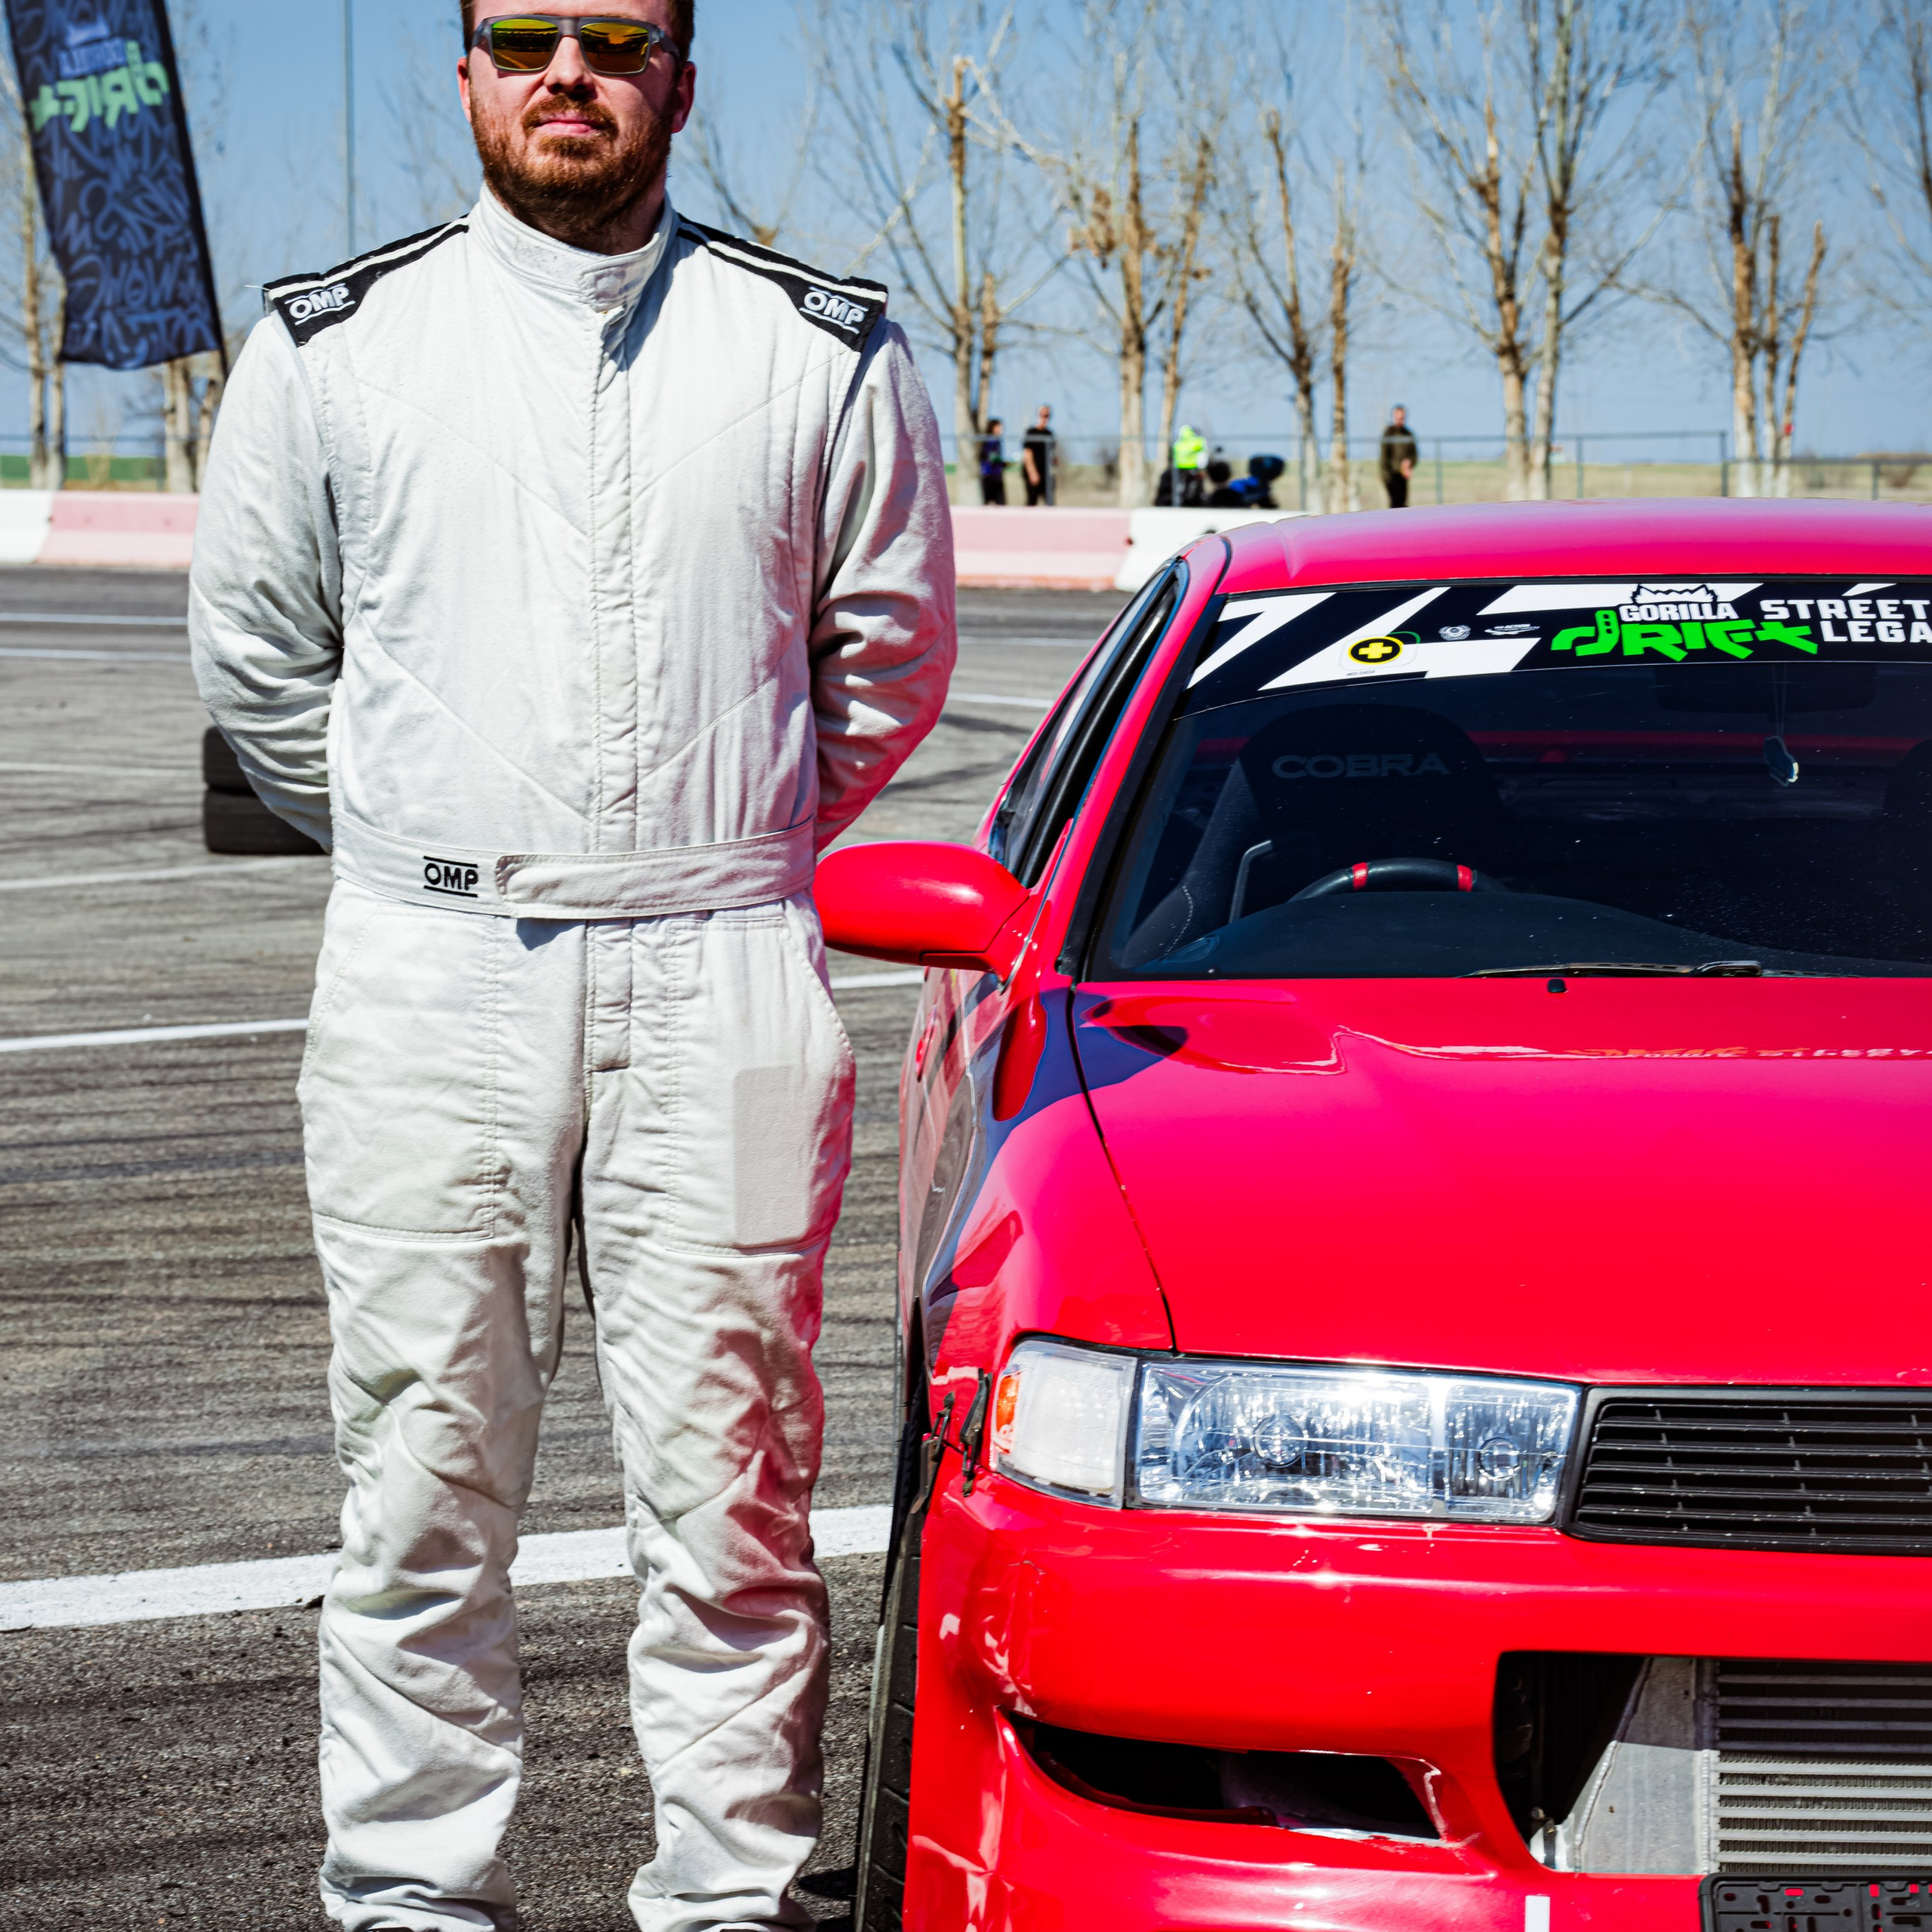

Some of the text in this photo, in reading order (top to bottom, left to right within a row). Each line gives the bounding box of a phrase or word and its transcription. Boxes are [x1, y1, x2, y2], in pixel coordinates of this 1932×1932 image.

[289, 285, 349, 318] OMP
[804, 291, 866, 325] OMP
[1619, 603, 1740, 622] GORILLA
[1760, 599, 1930, 619] STREET
[1272, 753, 1451, 779] COBRA
[424, 863, 478, 891] OMP
